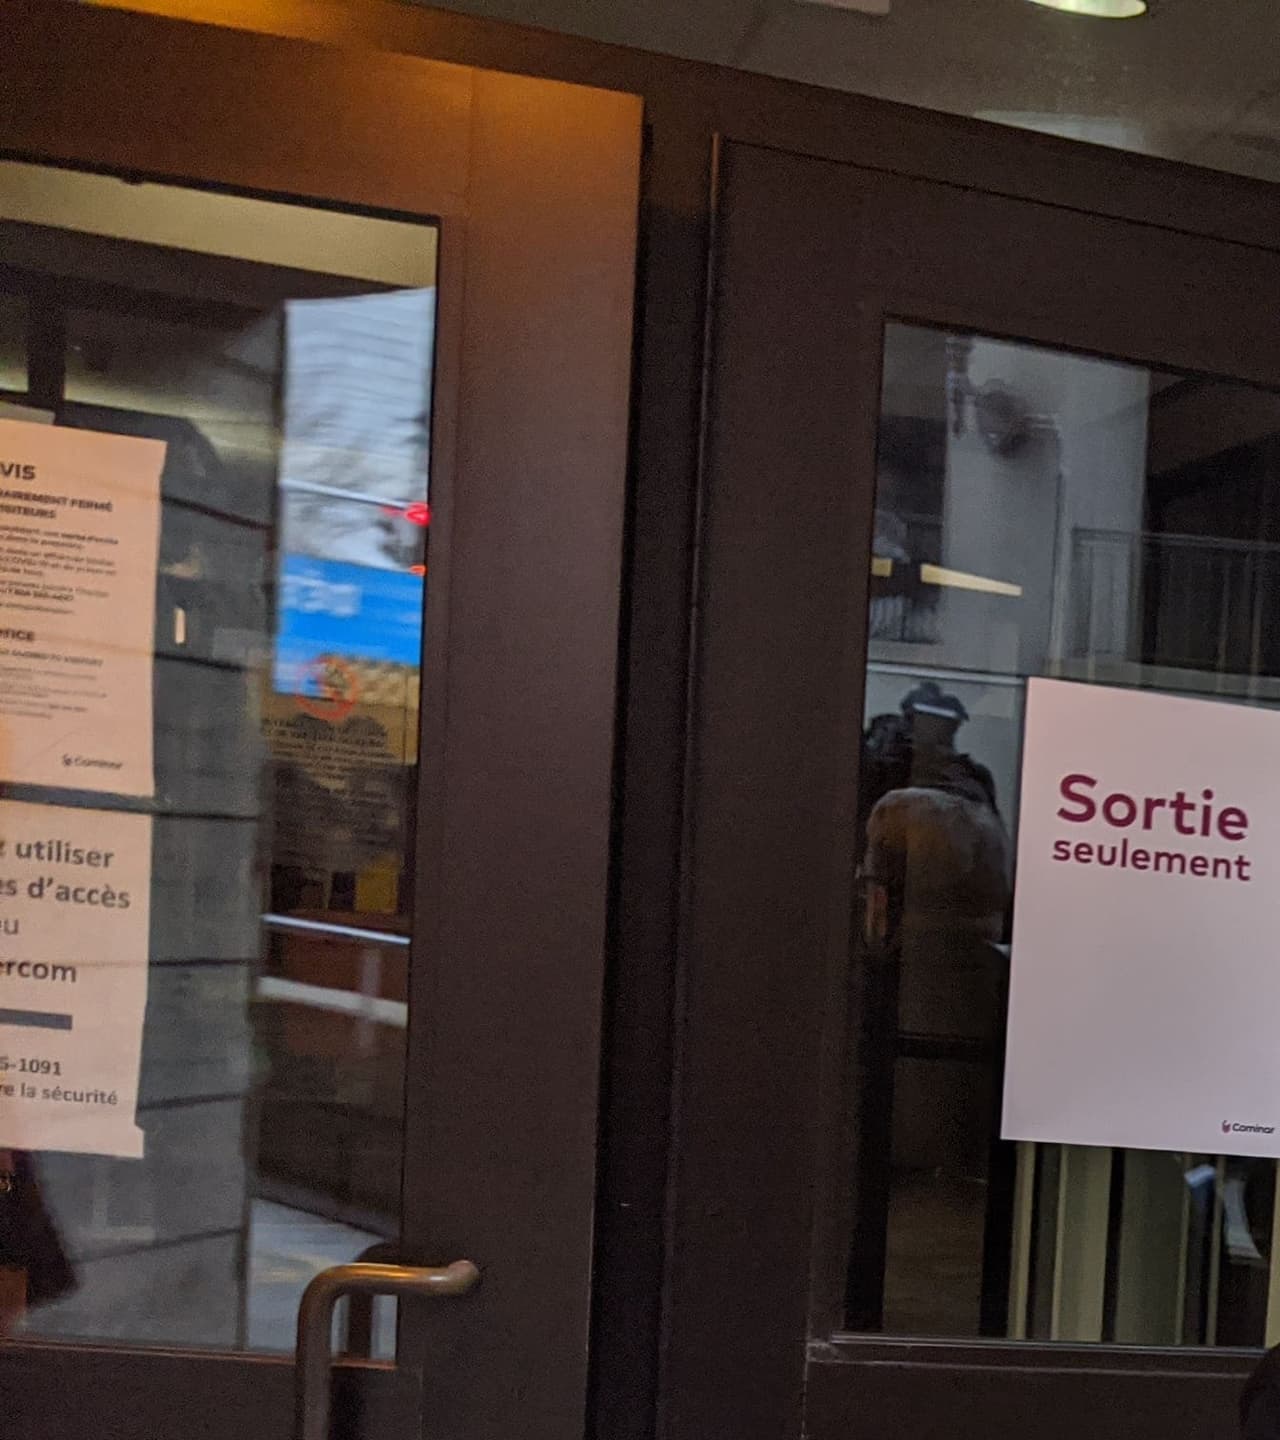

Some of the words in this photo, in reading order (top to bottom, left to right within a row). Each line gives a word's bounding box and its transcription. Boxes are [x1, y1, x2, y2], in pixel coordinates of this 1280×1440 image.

[1056, 774, 1249, 841] Sortie
[15, 840, 114, 868] utiliser
[1052, 837, 1251, 881] seulement
[21, 1082, 36, 1098] la
[42, 1085, 118, 1106] sécurité
[1232, 1122, 1275, 1136] Cominar
